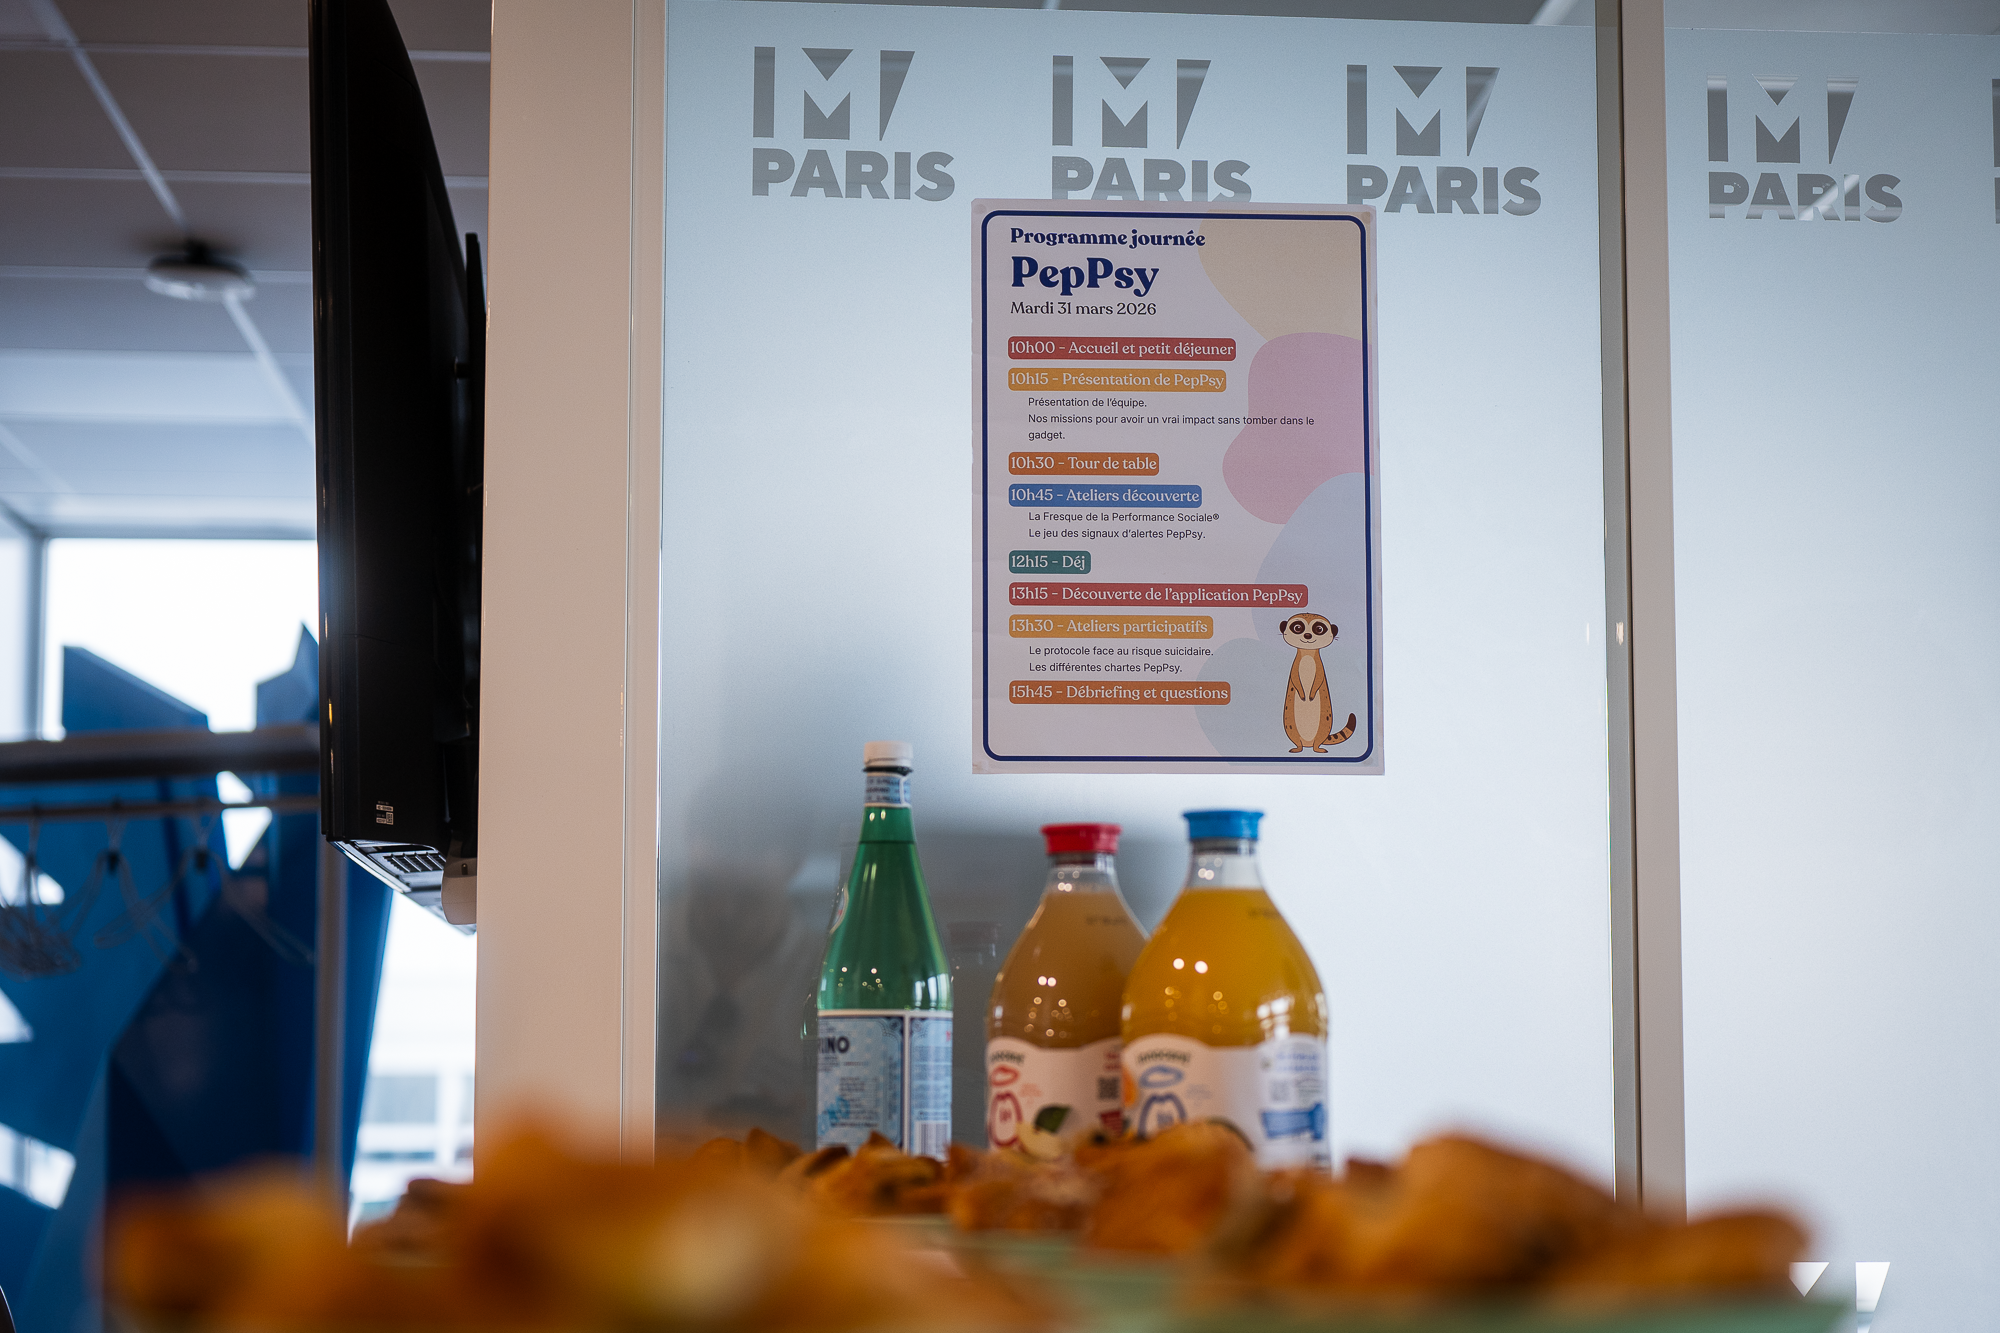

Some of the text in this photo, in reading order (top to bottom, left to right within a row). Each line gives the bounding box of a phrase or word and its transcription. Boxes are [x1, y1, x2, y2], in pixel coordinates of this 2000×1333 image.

[752, 148, 955, 201] PARIS
[1051, 156, 1252, 202] PARIS
[1347, 165, 1542, 216] PARIS
[1708, 172, 1904, 223] PARIS
[1010, 227, 1205, 250] Programme journée
[1011, 255, 1159, 297] PepPsy
[1010, 300, 1156, 315] Mardi 31 mars 2026
[1010, 340, 1055, 354] 10h00
[1068, 340, 1118, 354] Accueil
[1121, 343, 1135, 354] et
[1138, 341, 1171, 357] petit
[1173, 341, 1234, 358] déjeuner
[1010, 371, 1048, 385] 10h15
[1062, 372, 1151, 386] Présentation
[1153, 372, 1170, 386] de
[1174, 373, 1224, 389] PepPsy
[1028, 396, 1089, 407] Présentation
[1091, 397, 1104, 407] de
[1028, 413, 1314, 426] Nos missions pour avoir un vrai impact sans tomber dans le
[1027, 430, 1065, 442] gadget.
[1011, 455, 1054, 469] 10h30
[1067, 456, 1100, 469] Tour
[1102, 456, 1119, 469] de
[1121, 456, 1157, 470] table
[1011, 488, 1053, 501] 10h45
[1065, 488, 1119, 501] Ateliers
[1122, 488, 1200, 502] découverte
[1028, 511, 1040, 521] La
[1043, 511, 1083, 523] Fresque
[1085, 511, 1098, 521] de
[1100, 512, 1109, 521] la
[1111, 511, 1175, 522] Performance
[1028, 528, 1041, 538] Le
[1042, 528, 1058, 539] jeu
[1060, 528, 1079, 538] des
[1081, 528, 1119, 540] signaux
[1166, 528, 1205, 540] PepPsy.
[1011, 554, 1048, 568] 12h15
[1062, 555, 1085, 571] Déj
[1011, 586, 1048, 599] 13h15
[1062, 586, 1142, 600] Découverte
[1144, 587, 1162, 600] de
[1252, 588, 1303, 605] PepPsy
[1011, 618, 1053, 632] 13h30
[1066, 618, 1120, 632] Ateliers
[1122, 619, 1208, 636] participatifs
[1029, 645, 1041, 655] Le
[1043, 645, 1090, 657] protocole
[1092, 645, 1114, 655] face
[1131, 646, 1162, 657] risque
[1164, 646, 1214, 656] suicidaire.
[1029, 662, 1182, 674] Les différentes chartes PepPsy.
[1012, 684, 1052, 698] 15h45
[1066, 684, 1140, 700] Débriefing
[1143, 687, 1157, 698] et
[1160, 685, 1228, 702] questions
